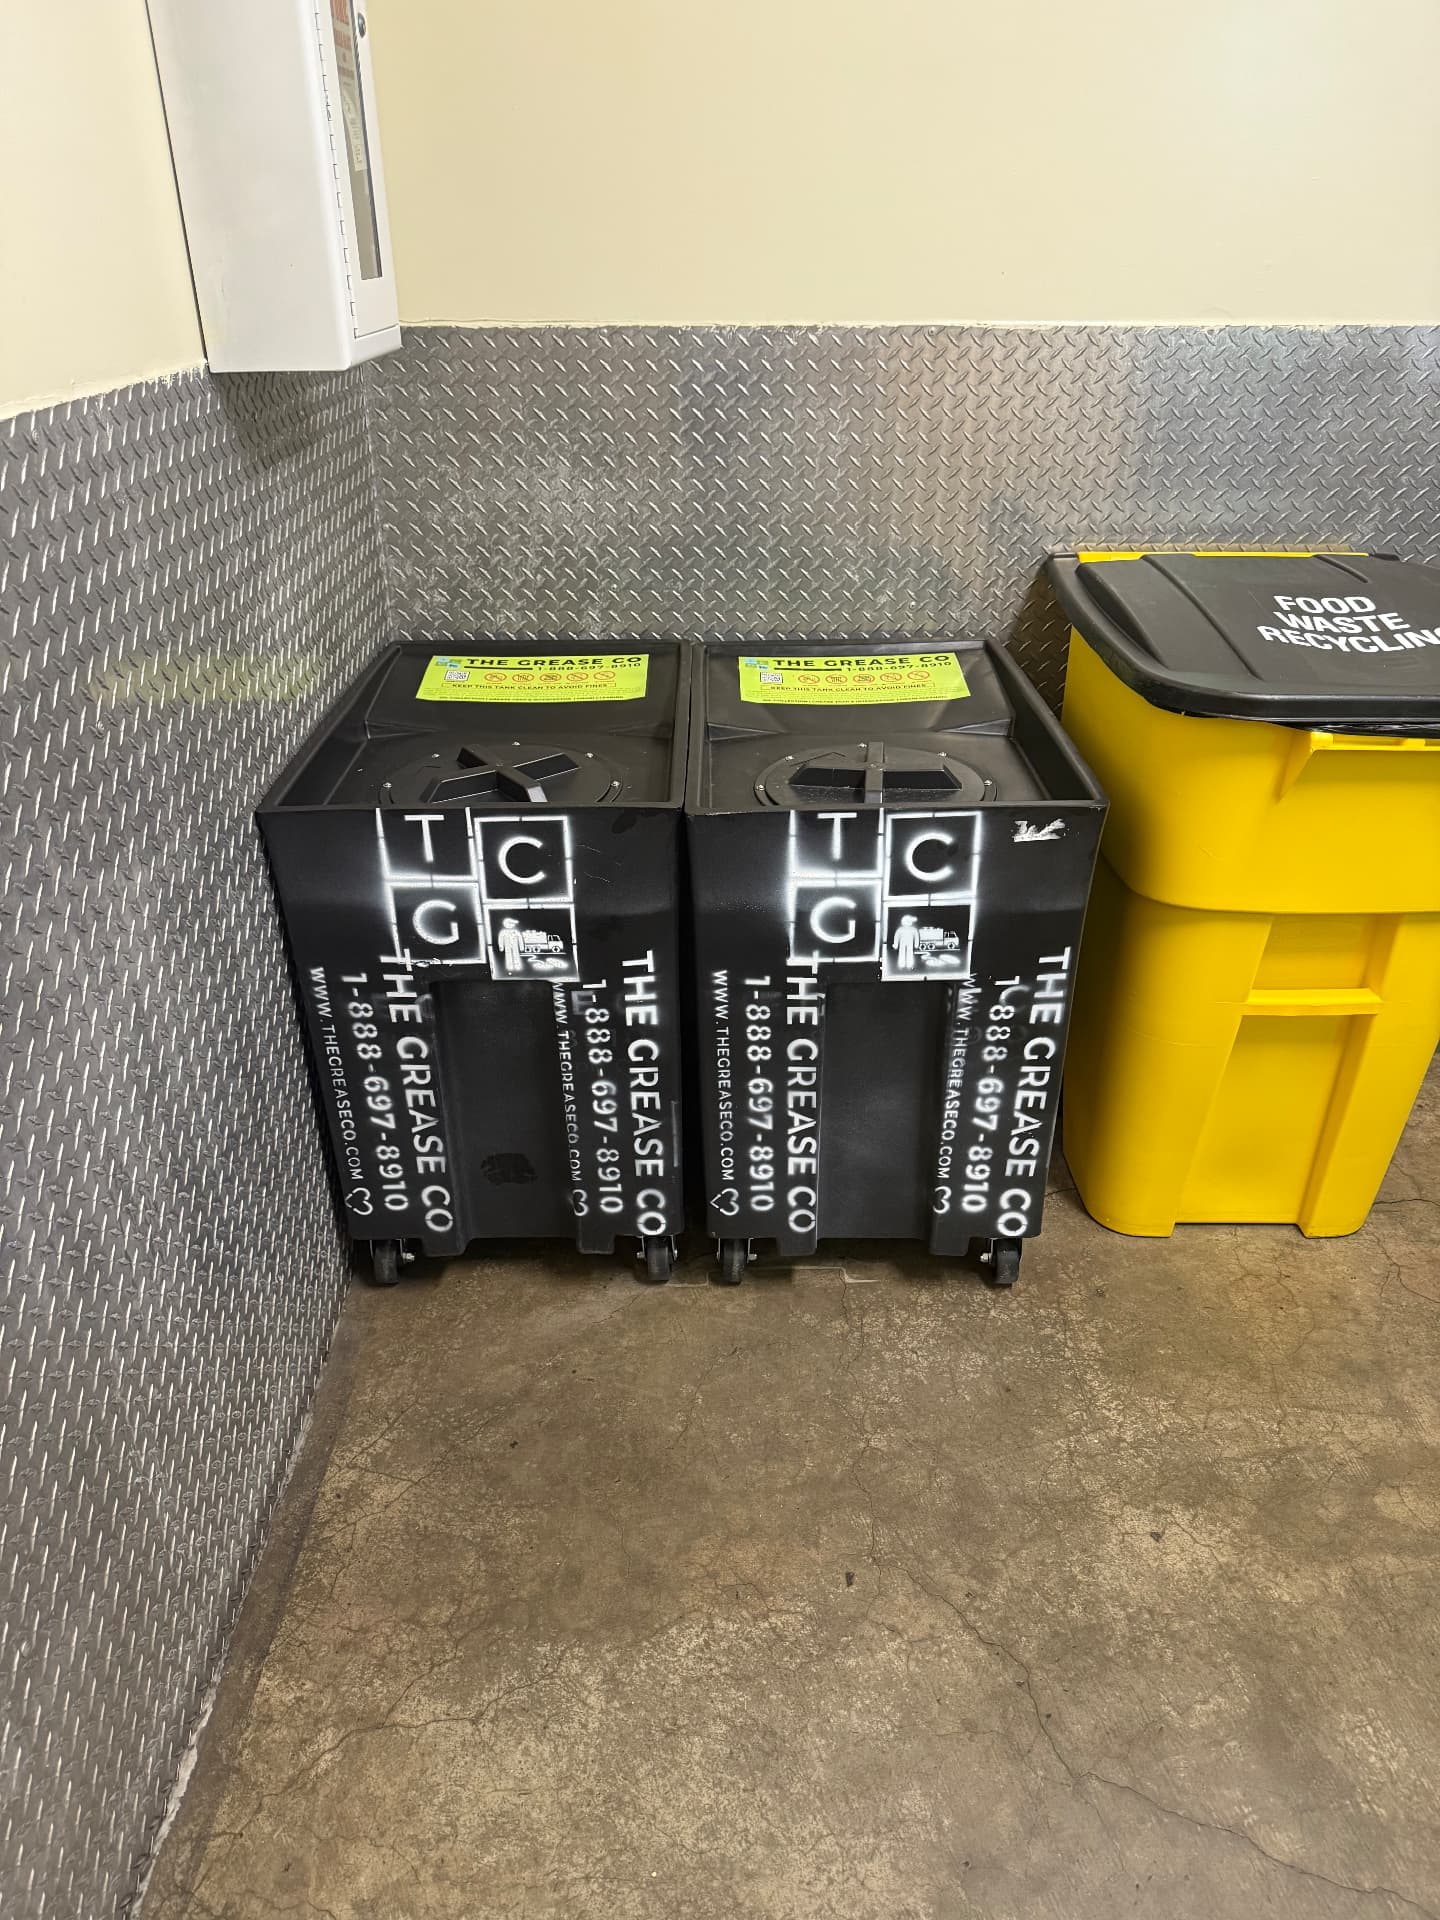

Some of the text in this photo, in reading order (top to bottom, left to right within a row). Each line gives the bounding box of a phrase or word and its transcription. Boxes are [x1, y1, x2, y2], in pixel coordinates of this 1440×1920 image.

[1272, 612, 1411, 634] WASTE
[1273, 595, 1376, 614] FOOD
[467, 656, 642, 666] THE GREASE CO
[537, 663, 641, 671] 1-888-697-8910
[772, 659, 815, 667] THE
[824, 657, 911, 667] GREASE
[847, 662, 952, 671] 1-888-697-8910
[404, 814, 545, 885] T C
[816, 811, 953, 882] T C
[412, 899, 459, 945] G
[809, 896, 856, 944] G
[340, 972, 410, 1212] 1-888-697-8910
[380, 948, 454, 1233] THE GREASE CO
[582, 979, 624, 1214] 1-888-697-8910
[621, 950, 667, 1236] THE GREASE CO
[743, 975, 776, 1212] 1-888-697-8910
[786, 950, 820, 1234] THE GREASE CO
[996, 946, 1072, 1237] THE GREASE CO
